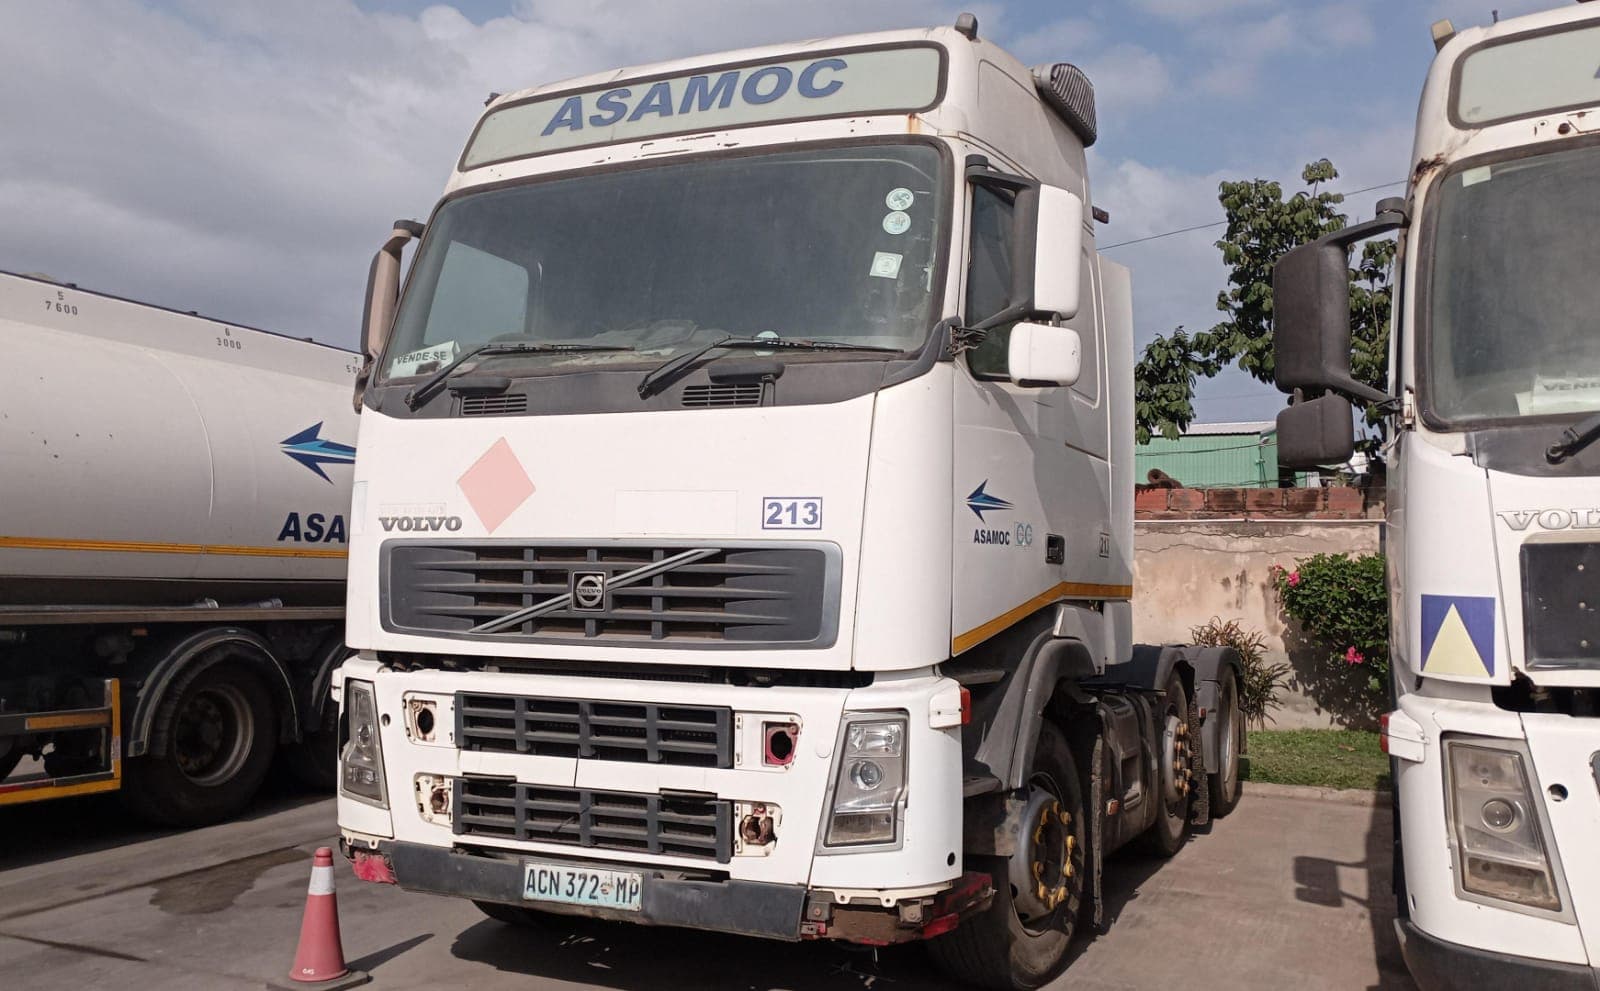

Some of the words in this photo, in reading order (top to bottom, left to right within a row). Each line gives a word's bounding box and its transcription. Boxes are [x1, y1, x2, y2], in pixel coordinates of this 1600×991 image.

[540, 58, 848, 137] ASAMOC
[397, 351, 447, 364] VENDE-SE
[378, 516, 463, 532] VOLVO
[766, 502, 819, 525] 213
[277, 512, 349, 544] ASA
[973, 529, 1010, 545] ASAMOC
[526, 868, 560, 896] ACN
[565, 872, 599, 900] 372
[616, 876, 640, 904] MP
